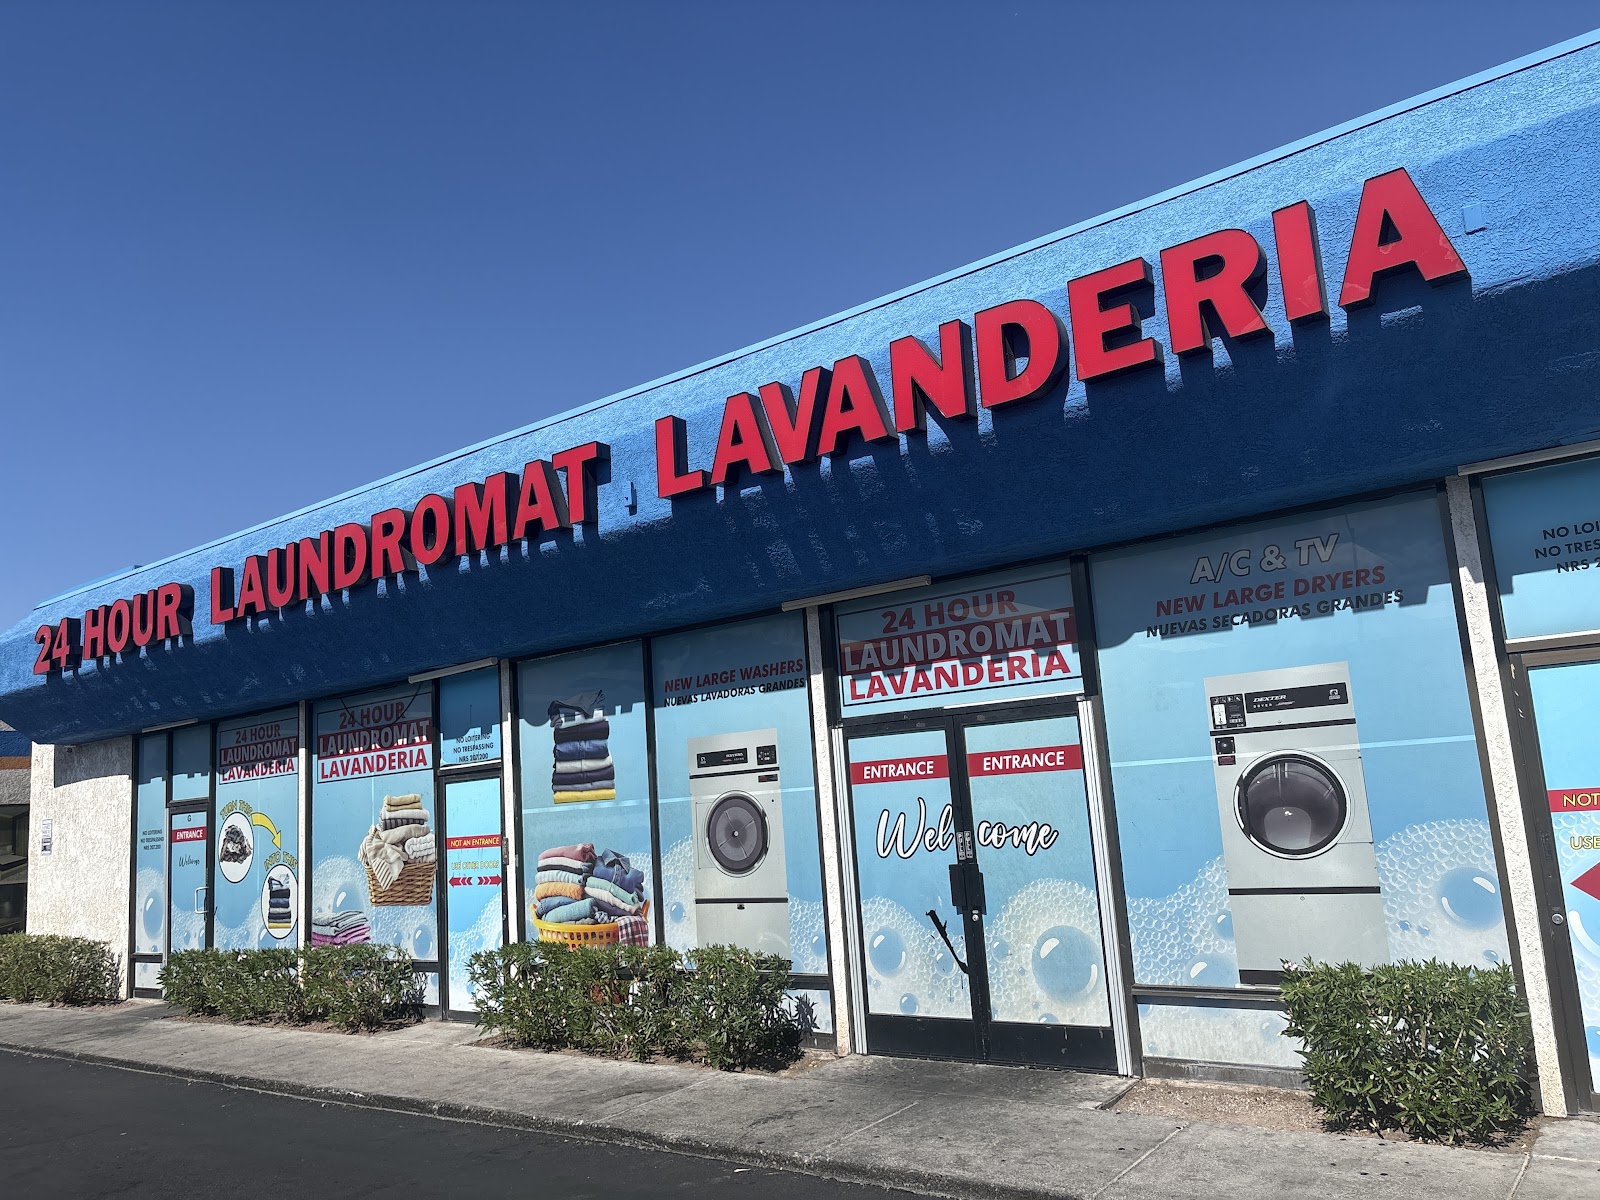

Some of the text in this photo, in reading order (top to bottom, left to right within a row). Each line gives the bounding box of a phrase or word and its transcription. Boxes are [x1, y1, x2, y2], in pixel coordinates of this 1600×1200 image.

[33, 167, 1468, 675] 24 HOUR LAUNDROMAT LAVANDERIA
[1542, 526, 1570, 540] NO
[1190, 533, 1340, 584] A/C & TV
[1534, 545, 1562, 559] NO
[1556, 558, 1590, 573] NRS
[1155, 565, 1386, 617] NEW LARGE DRYERS
[882, 590, 1019, 634] 24 HOUR
[1146, 589, 1405, 638] NUEVAS SECADORAS GRANDES
[844, 612, 1070, 672] LAUNDROMAT
[664, 658, 804, 693] NEW LARGE WASHERS
[849, 649, 1071, 701] LAVANDERIA
[663, 677, 806, 708] NUEVAS LAVADORAS GRANDES
[1252, 694, 1287, 703] DEXTER
[339, 701, 406, 730] 24 HOUR
[235, 723, 281, 744] 24 HOUR
[319, 719, 430, 757] LAUNDROMAT
[456, 732, 491, 744] NO LOITERING
[220, 737, 297, 765] LAUNDROMAT
[462, 742, 494, 753] TRESPASSING
[221, 757, 295, 782] LAVANDERIA
[320, 748, 428, 780] LAVANDERIA
[458, 755, 469, 763] NRS
[982, 751, 1066, 772] ENTRANCE
[862, 760, 935, 780] ENTRANCE
[238, 799, 253, 818] THIS
[1562, 793, 1600, 808] NOT
[187, 814, 192, 822] G
[176, 829, 203, 840] ENTRANCE
[450, 836, 500, 847] NOT AN ENTRANCE
[1570, 835, 1600, 850] USE
[282, 851, 299, 870] THIS
